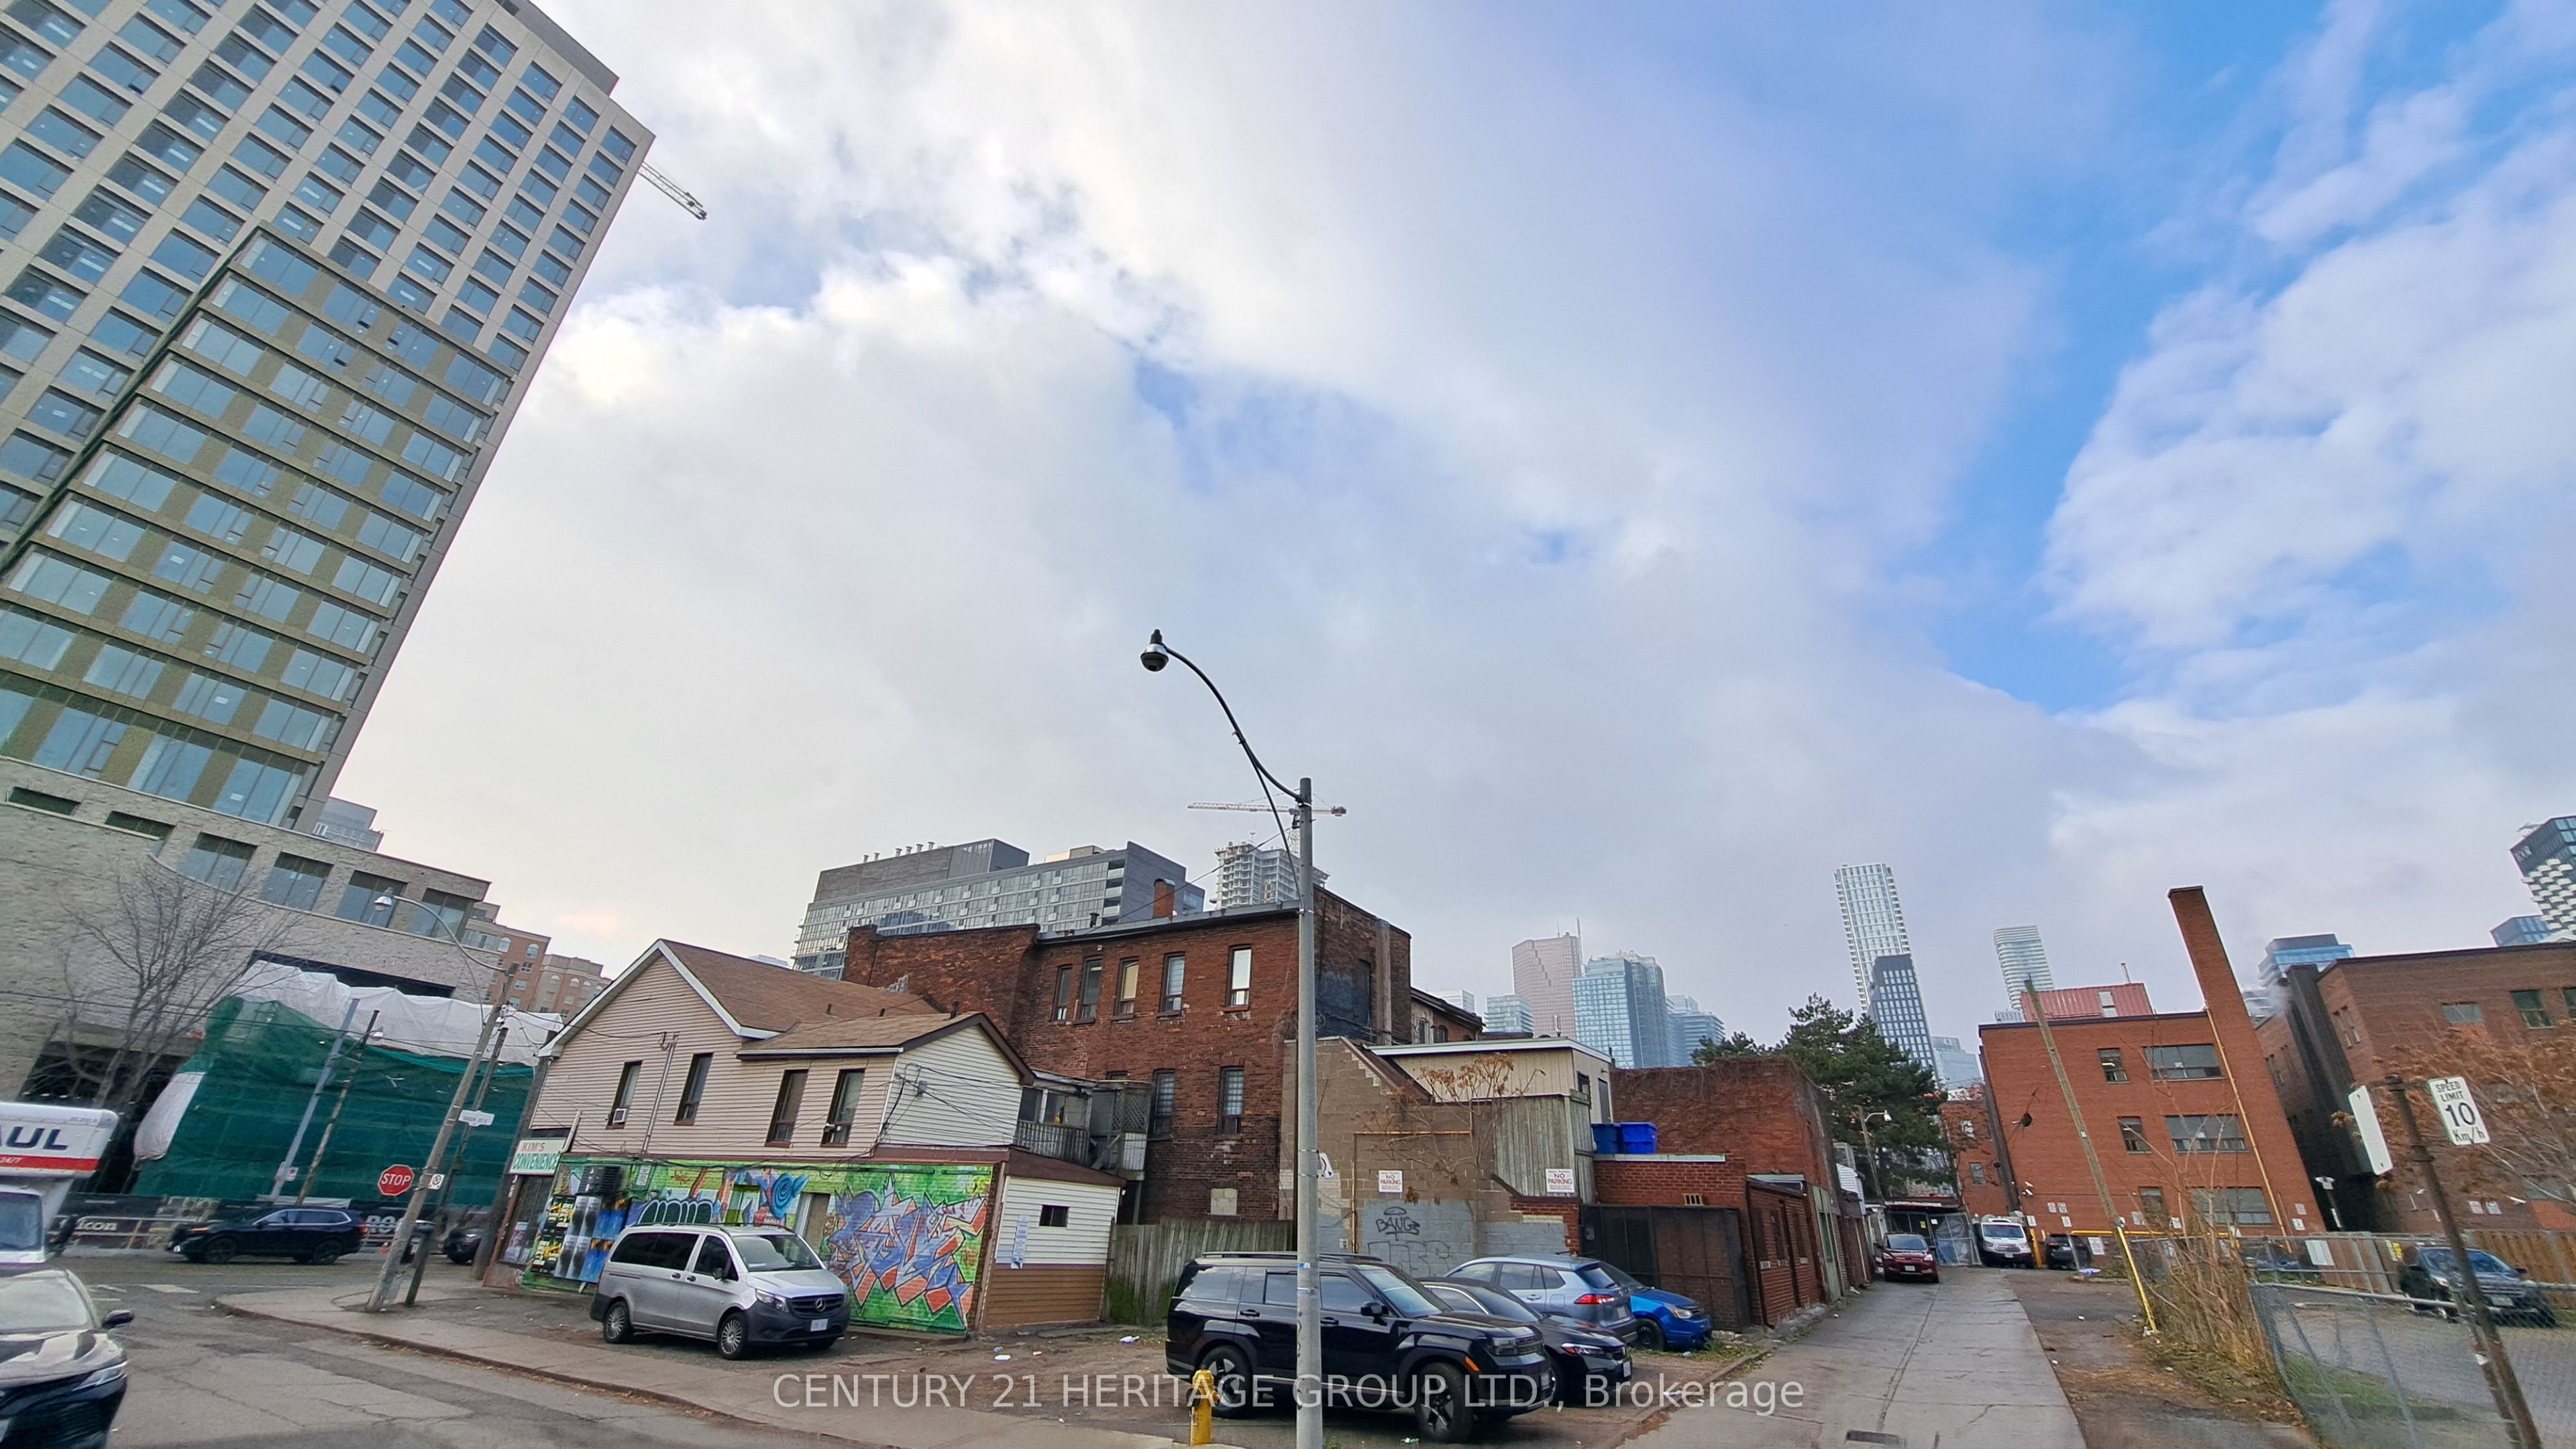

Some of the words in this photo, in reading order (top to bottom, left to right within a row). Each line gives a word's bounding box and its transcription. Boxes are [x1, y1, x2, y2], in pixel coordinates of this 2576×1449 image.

[2436, 1081, 2461, 1093] SPEED
[2440, 1091, 2464, 1102] LIMIT
[2445, 1102, 2475, 1126] 10
[0, 1126, 68, 1150] UL
[521, 1142, 545, 1151] KIM'S
[381, 1173, 411, 1185] STOP
